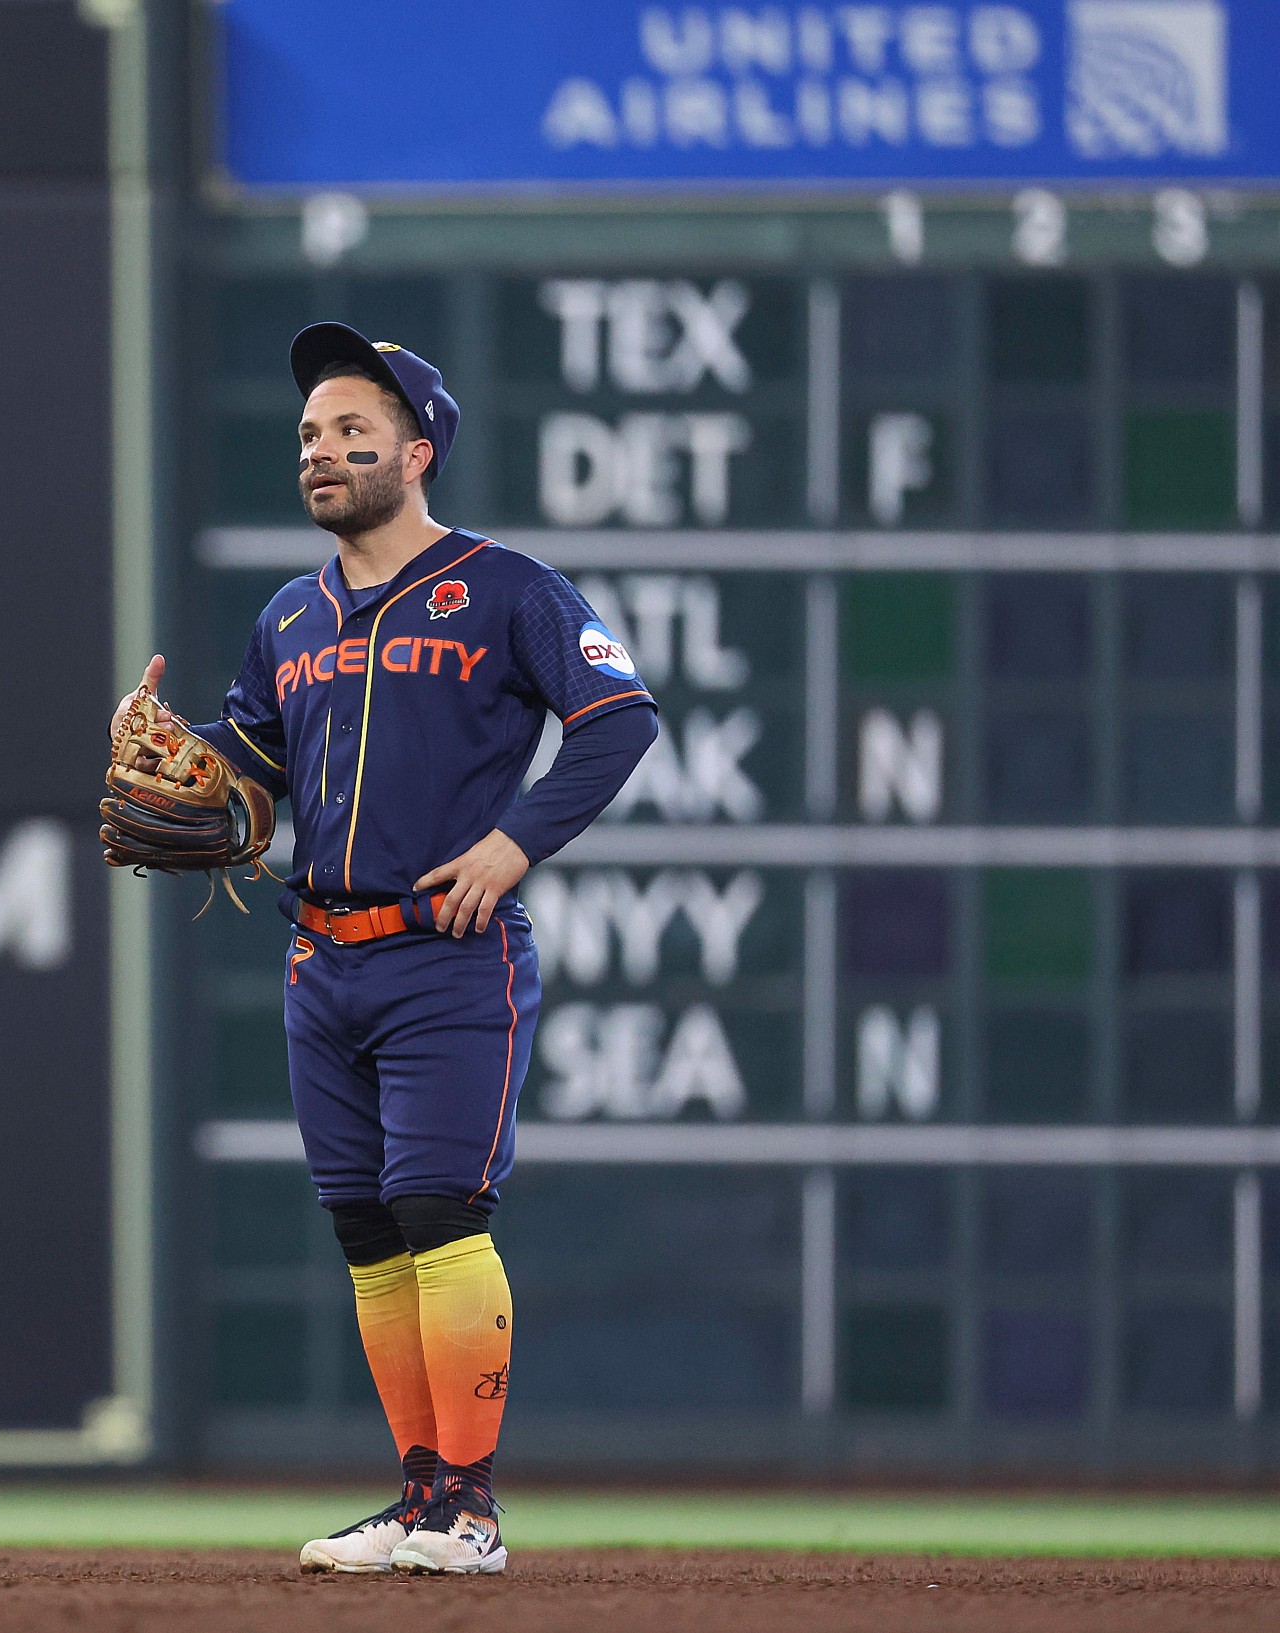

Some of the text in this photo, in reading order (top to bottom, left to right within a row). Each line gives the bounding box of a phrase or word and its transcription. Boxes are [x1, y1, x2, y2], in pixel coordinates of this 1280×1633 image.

[641, 6, 1039, 75] UNITED
[544, 78, 1038, 146] AIRLINES
[1010, 187, 1066, 265] 2
[545, 279, 747, 392] TEX
[540, 412, 928, 526] DET F
[381, 637, 488, 681] CITY
[583, 645, 626, 660] OXY
[530, 710, 941, 821] AK N
[533, 870, 760, 983] NYY
[540, 1004, 938, 1121] SEA N
